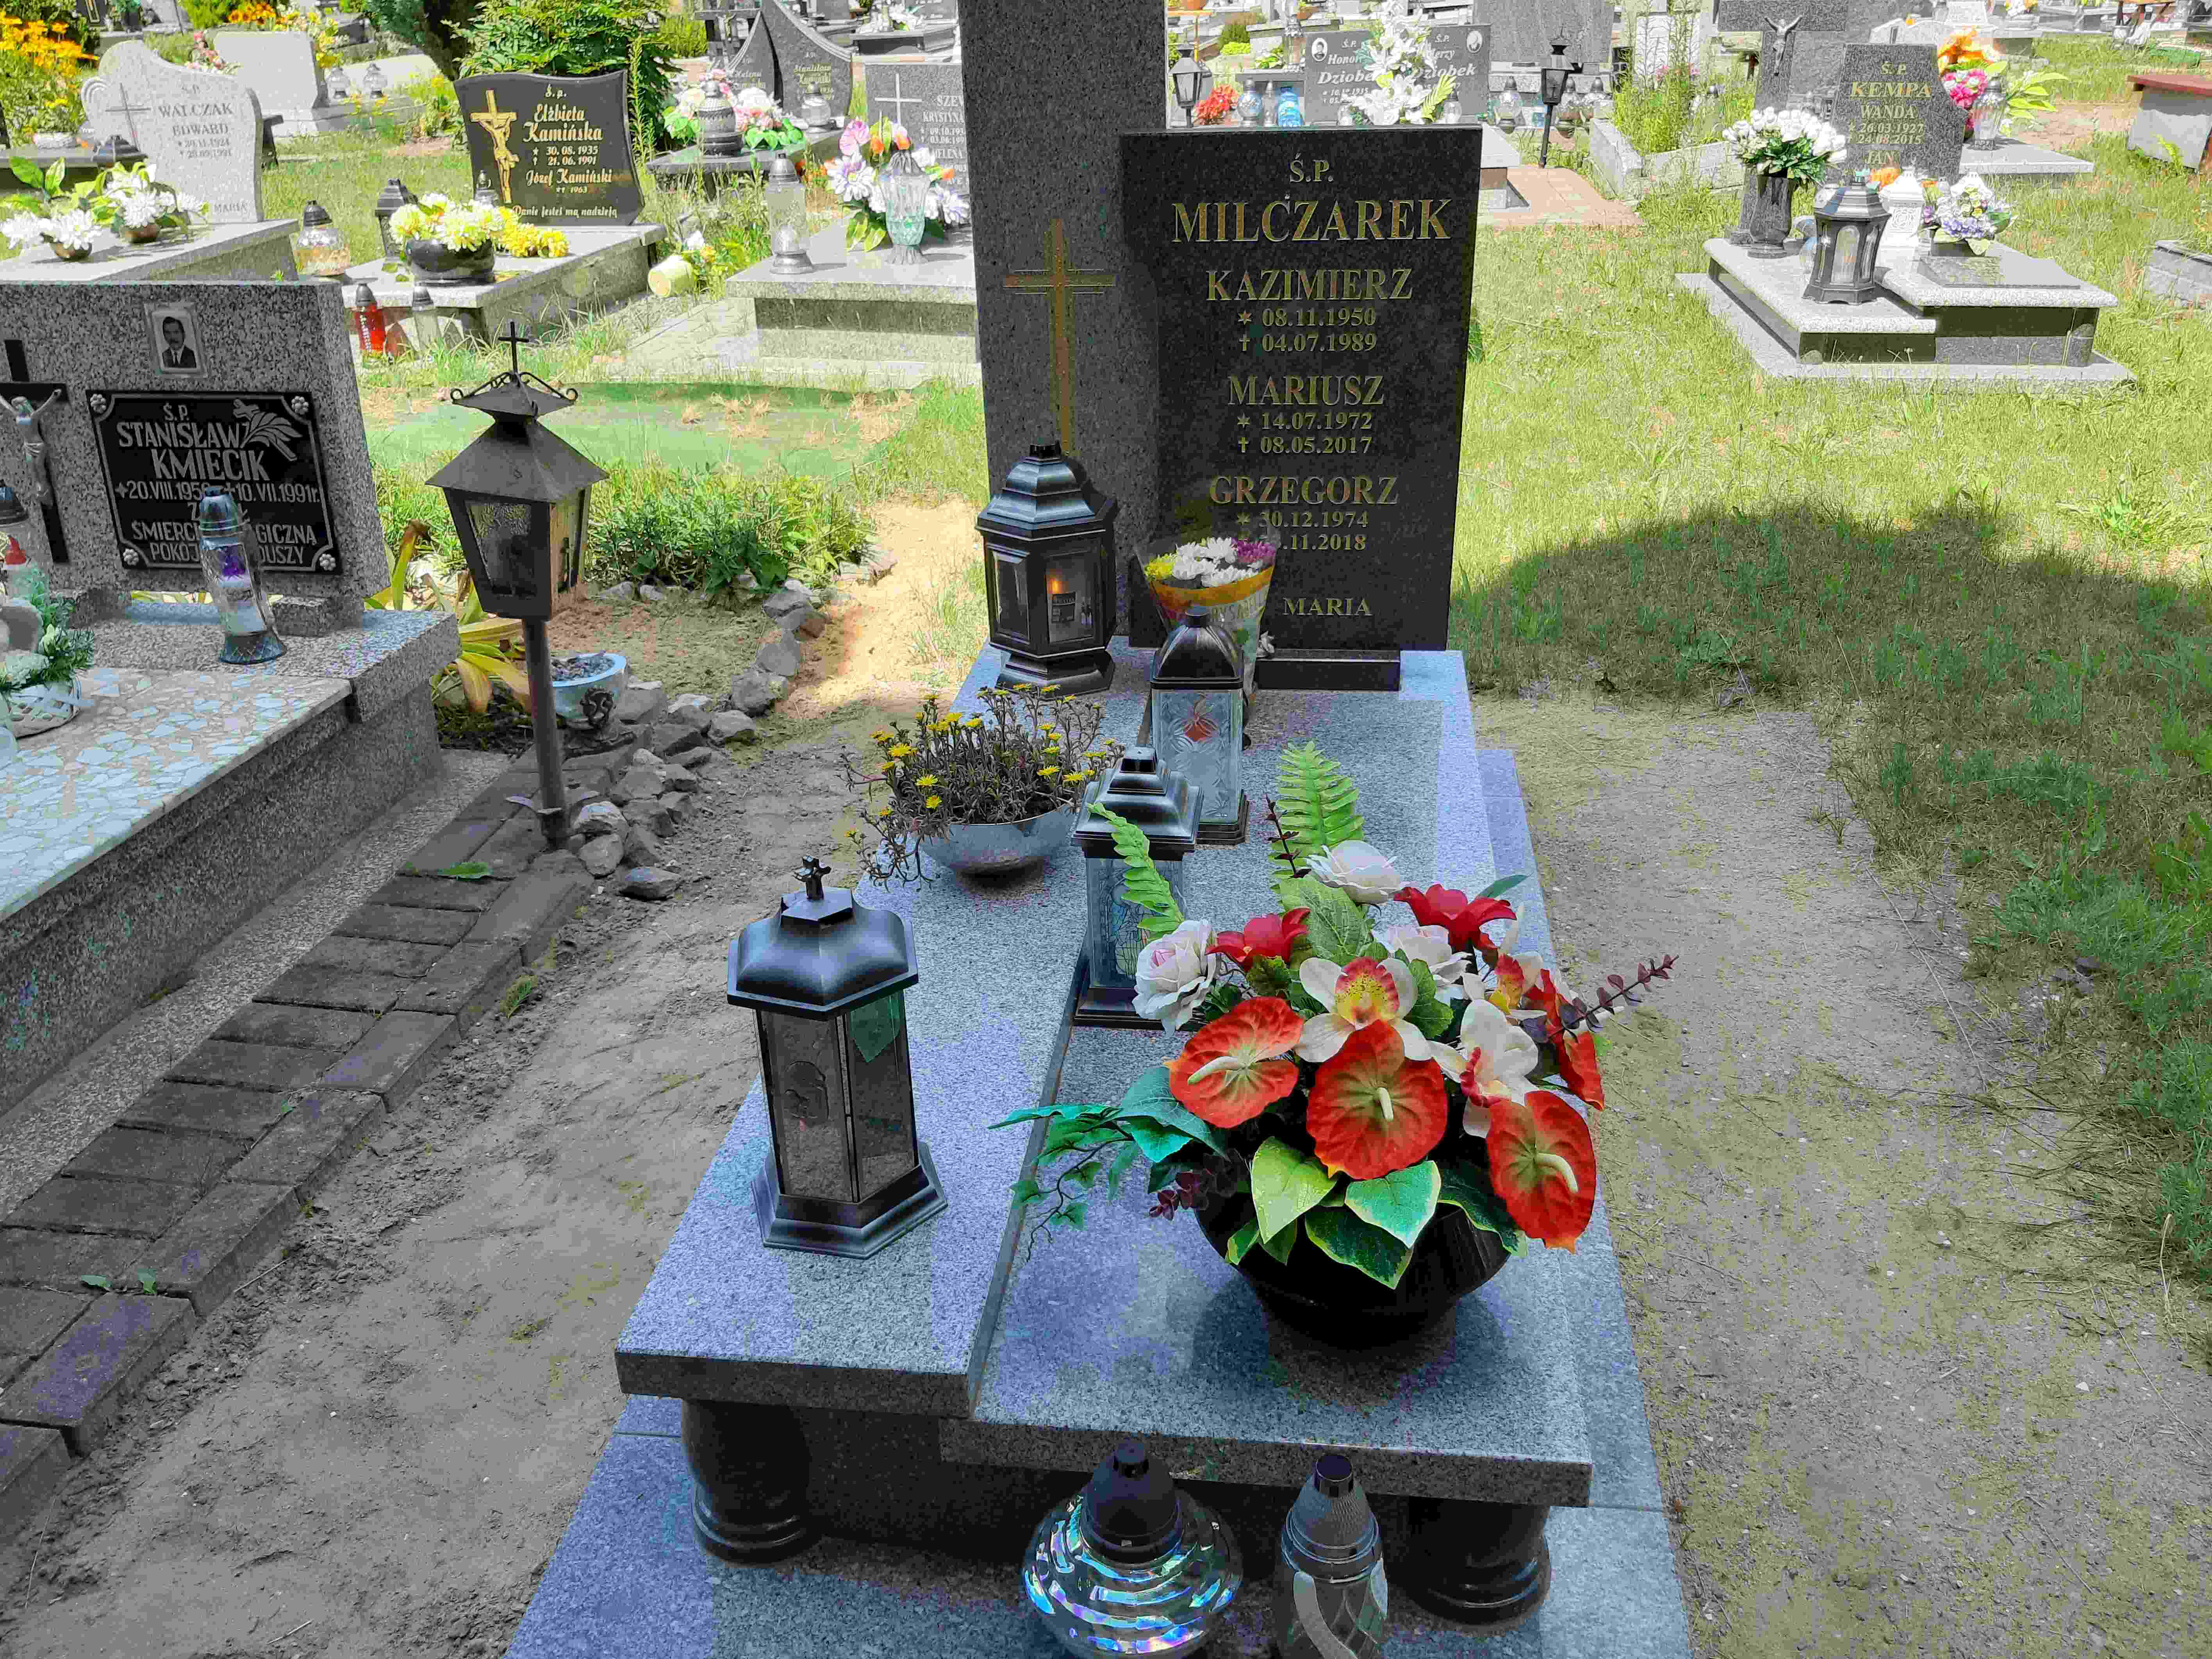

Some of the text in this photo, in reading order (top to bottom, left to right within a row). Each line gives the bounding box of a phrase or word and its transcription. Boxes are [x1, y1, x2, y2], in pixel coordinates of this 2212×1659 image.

[1850, 80, 1931, 98] KEMPA
[158, 103, 234, 117] WALCZAK
[534, 103, 585, 122] Elżbieta
[1861, 105, 1917, 119] WANDA
[172, 123, 229, 137] EDWARD
[523, 120, 604, 142] Kamińska
[526, 168, 613, 187] Józef Kamiński
[1289, 153, 1334, 183] Ś.P.
[214, 202, 248, 213] MARIA
[1171, 198, 1452, 243] MILCZAREK
[1206, 268, 1413, 301] KAZIMIERZ
[1262, 308, 1376, 326] 08.11.1950
[1262, 332, 1377, 352] 04.07.1989
[1227, 375, 1384, 406] MARIUSZ
[1261, 412, 1372, 430] 14.07.1972
[118, 421, 240, 448] STANISŁAW
[1260, 436, 1372, 453] 08.05.2017
[151, 449, 270, 481] KMIECIK
[1210, 475, 1399, 505] GRZEGORZ
[1283, 597, 1372, 616] MARIA
